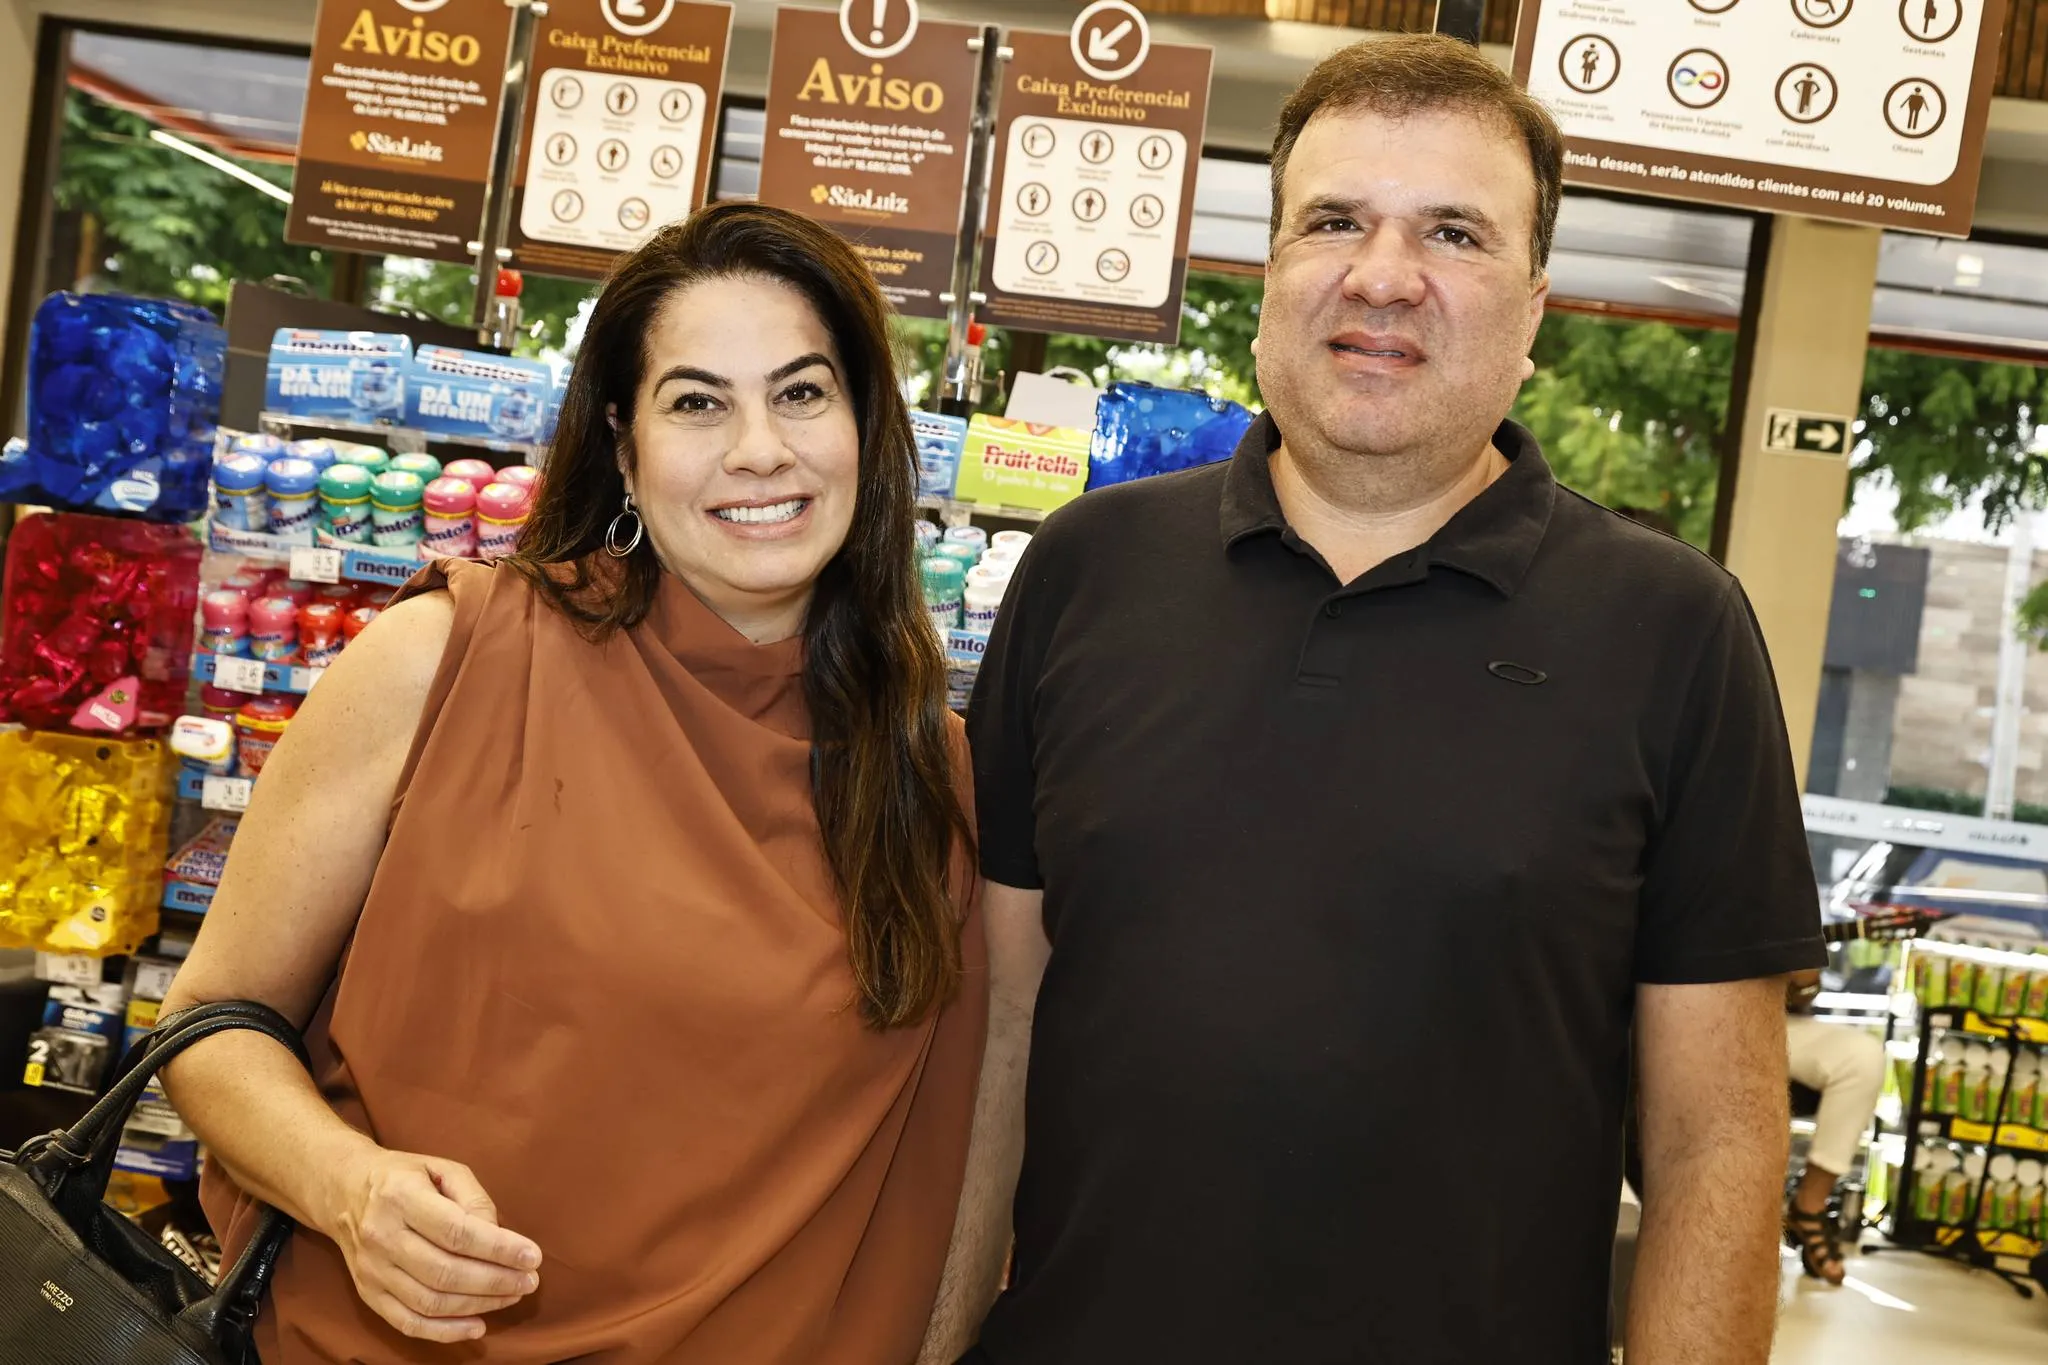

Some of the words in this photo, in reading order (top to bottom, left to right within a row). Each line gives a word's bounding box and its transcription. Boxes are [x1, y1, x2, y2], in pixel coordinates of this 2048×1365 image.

[340, 8, 480, 66] Aviso
[548, 28, 598, 50] Caixa
[602, 34, 711, 64] Preferencial
[585, 50, 670, 75] Exclusivo
[797, 57, 944, 114] Aviso
[1017, 74, 1070, 96] Caixa
[1075, 80, 1191, 109] Preferencial
[1057, 97, 1146, 121] Exclusivo
[1600, 156, 1647, 177] desses,
[1650, 164, 1687, 181] serão
[1689, 169, 1755, 190] atendidos
[1757, 178, 1809, 197] clientes
[1811, 188, 1840, 201] com
[1842, 190, 1865, 204] até
[1867, 194, 1884, 207] 20
[1887, 198, 1945, 216] volumes.
[984, 445, 1079, 477] Fruit-tella
[43, 1280, 73, 1307] AREZZO
